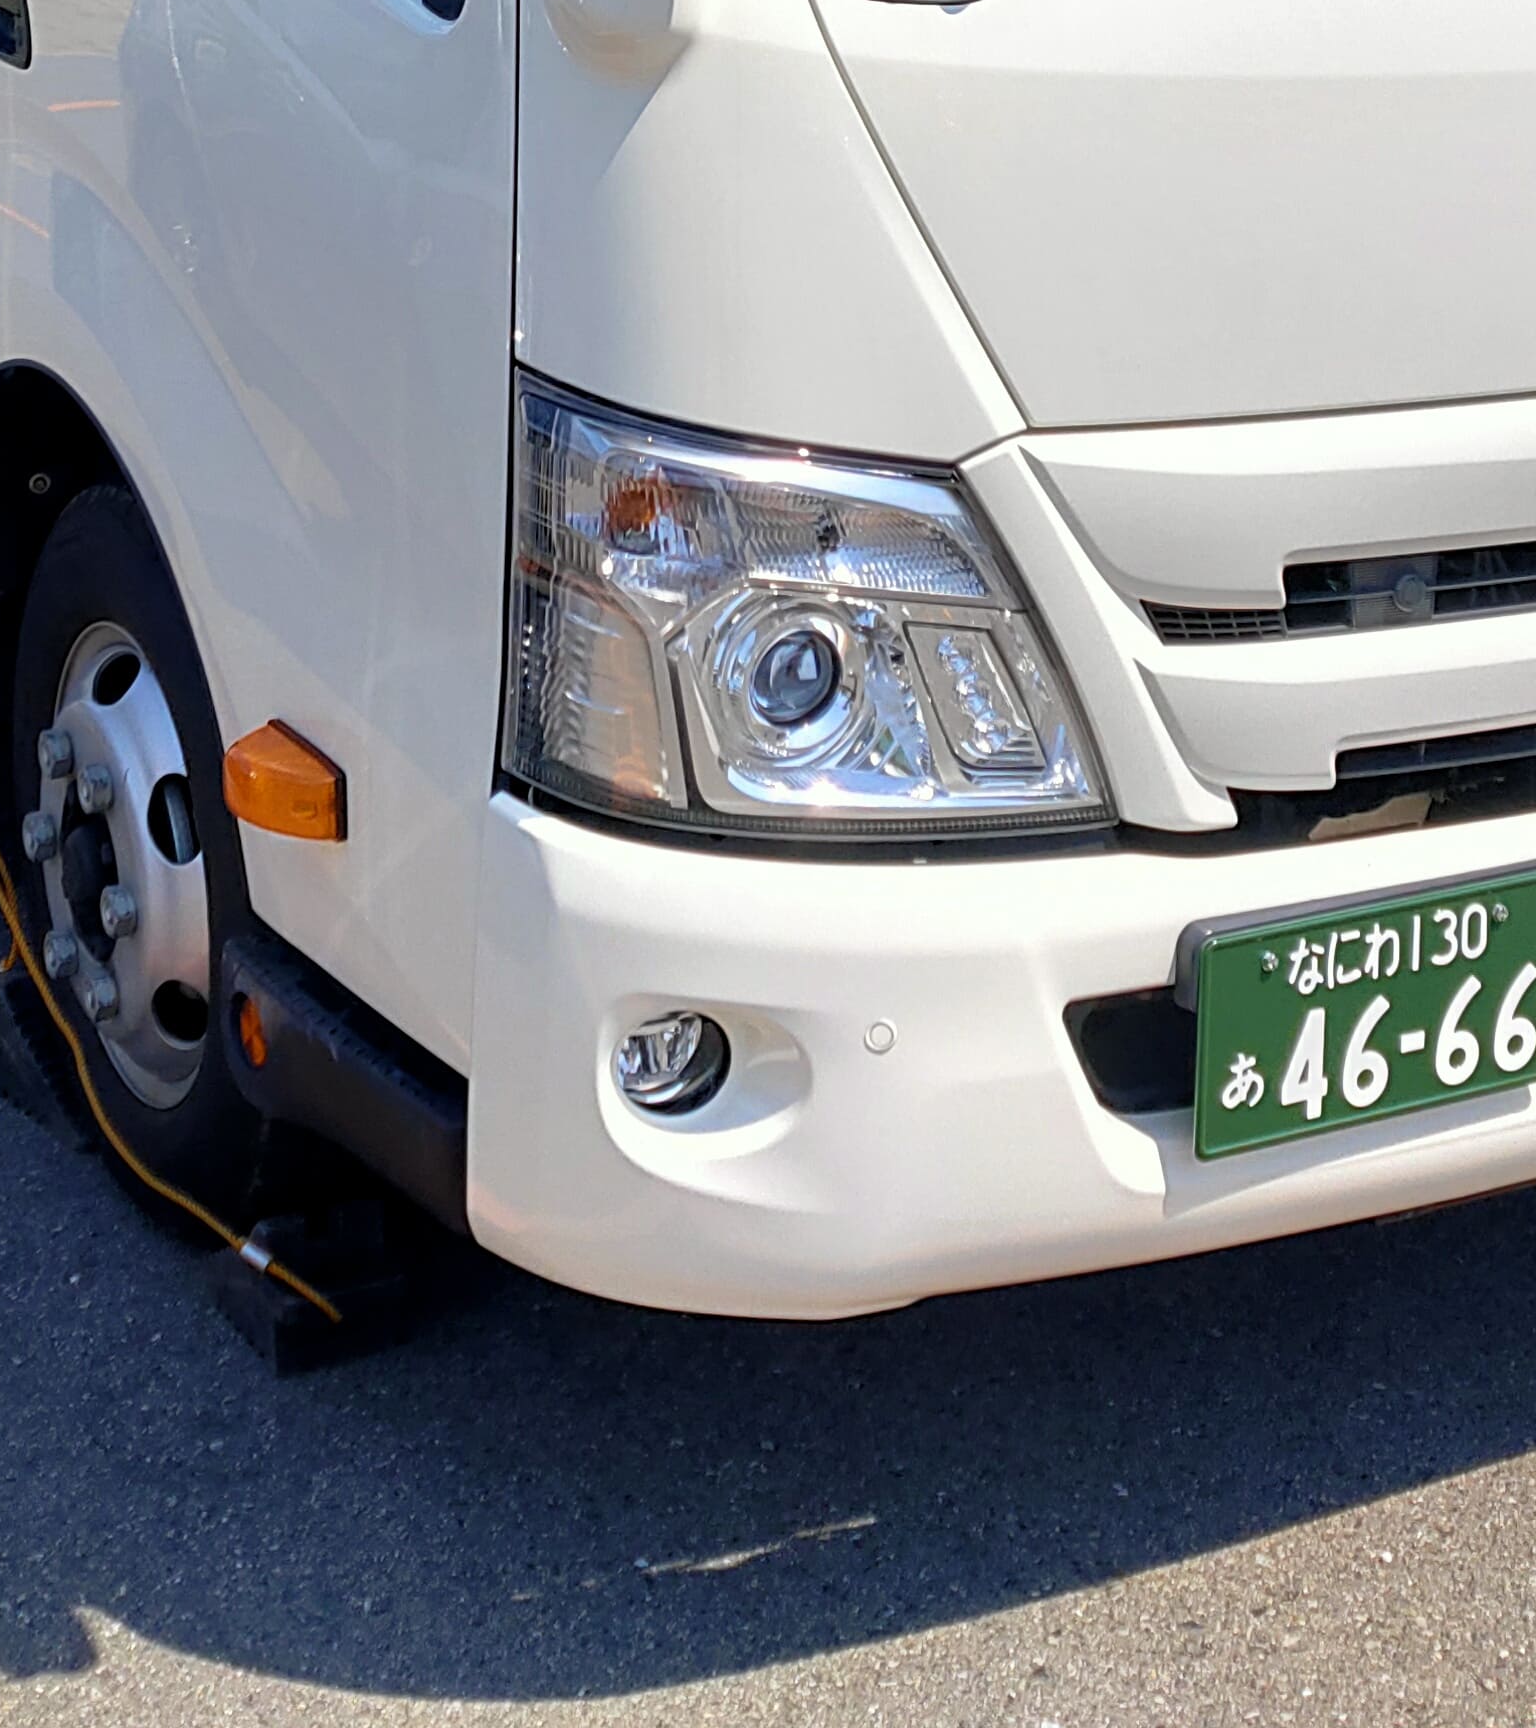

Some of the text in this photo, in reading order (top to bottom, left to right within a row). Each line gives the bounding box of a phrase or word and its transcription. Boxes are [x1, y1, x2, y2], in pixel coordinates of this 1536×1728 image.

[1287, 902, 1490, 996] なにわ 130
[1220, 1052, 1266, 1111] あ
